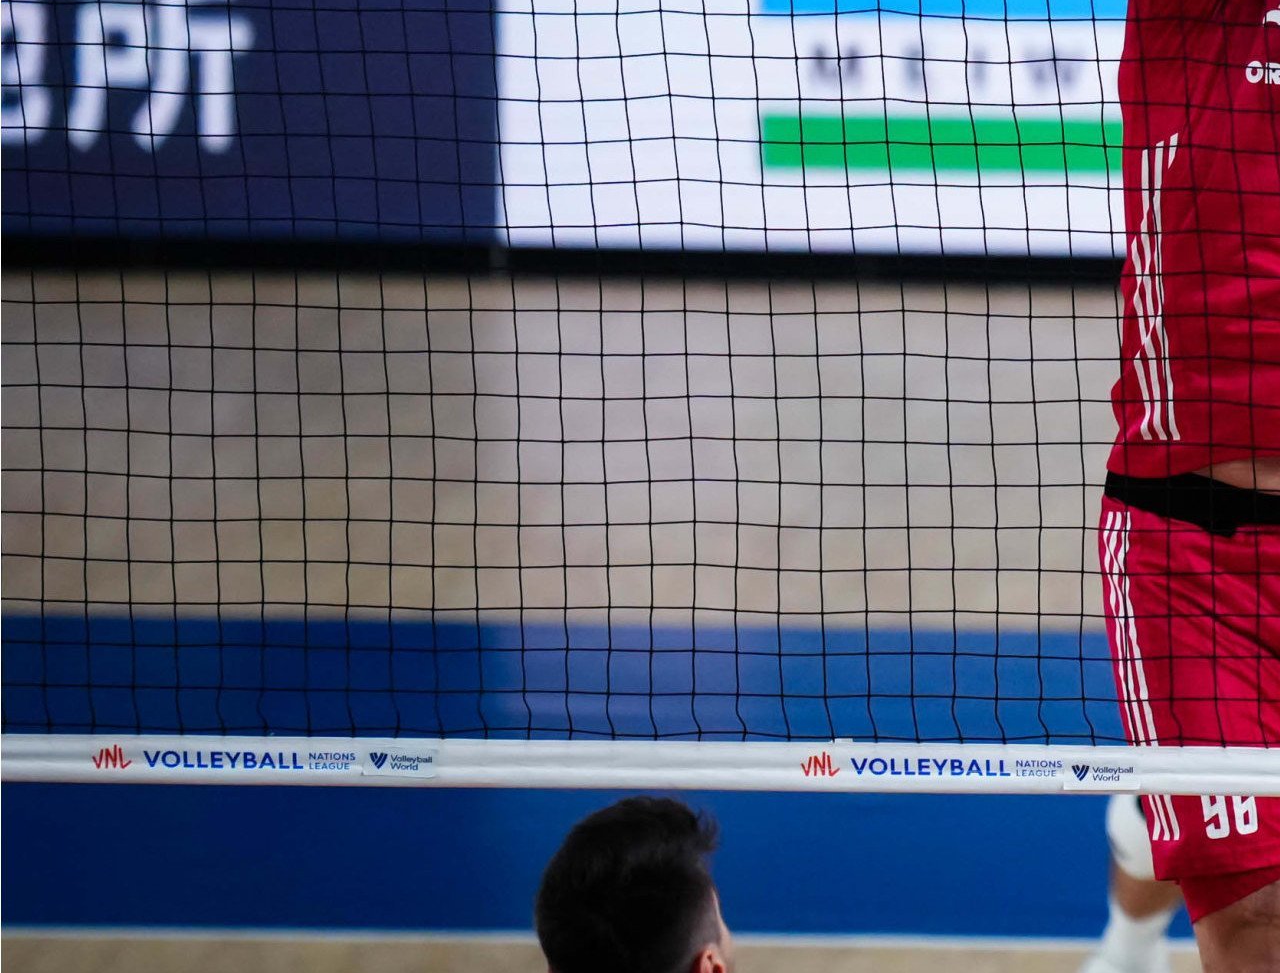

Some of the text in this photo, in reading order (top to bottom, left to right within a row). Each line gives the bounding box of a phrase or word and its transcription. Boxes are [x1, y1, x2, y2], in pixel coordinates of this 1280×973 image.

[143, 750, 304, 769] VOLLEYBALL
[308, 752, 356, 761] NATIONS
[391, 755, 433, 764] Volleyball
[309, 762, 350, 770] LEAGUE
[390, 763, 419, 771] World
[850, 758, 1011, 777] VOLLEYBALL
[1015, 760, 1062, 768] NATIONS
[1015, 769, 1057, 777] LEAGUE
[1092, 766, 1134, 775] Volleyball
[1092, 773, 1120, 781] World
